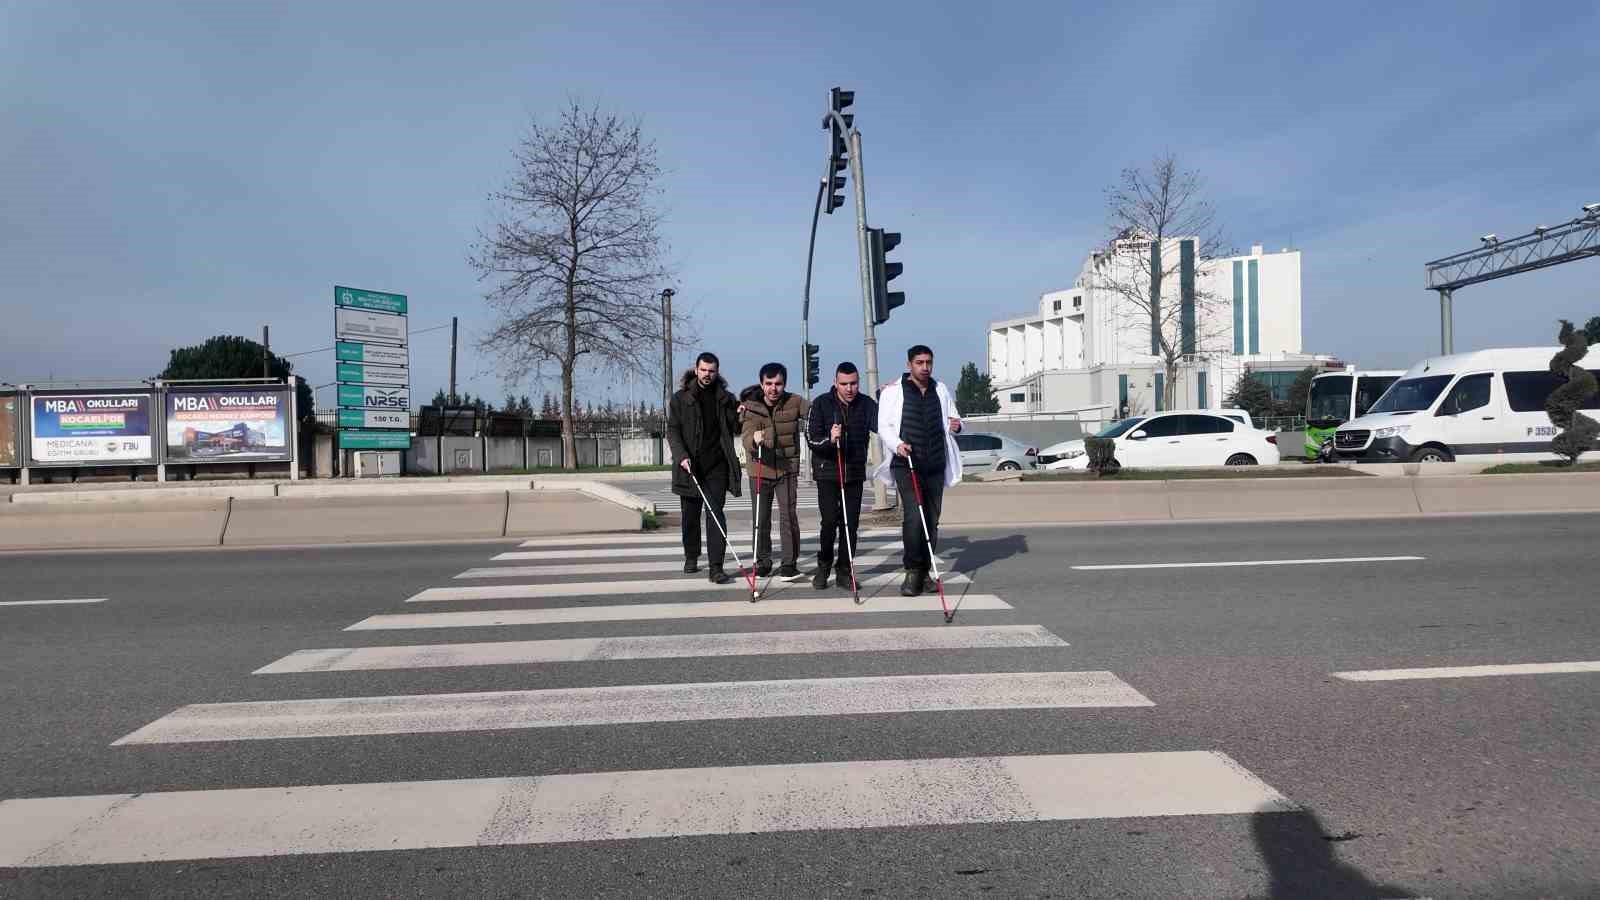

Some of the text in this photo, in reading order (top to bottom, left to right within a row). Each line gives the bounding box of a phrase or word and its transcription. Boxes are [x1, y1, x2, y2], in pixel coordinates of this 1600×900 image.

[45, 399, 138, 412] MBA OKULLARI
[174, 396, 277, 410] MBA OKULLARI
[365, 396, 408, 407] NRSE
[1527, 427, 1533, 436] P
